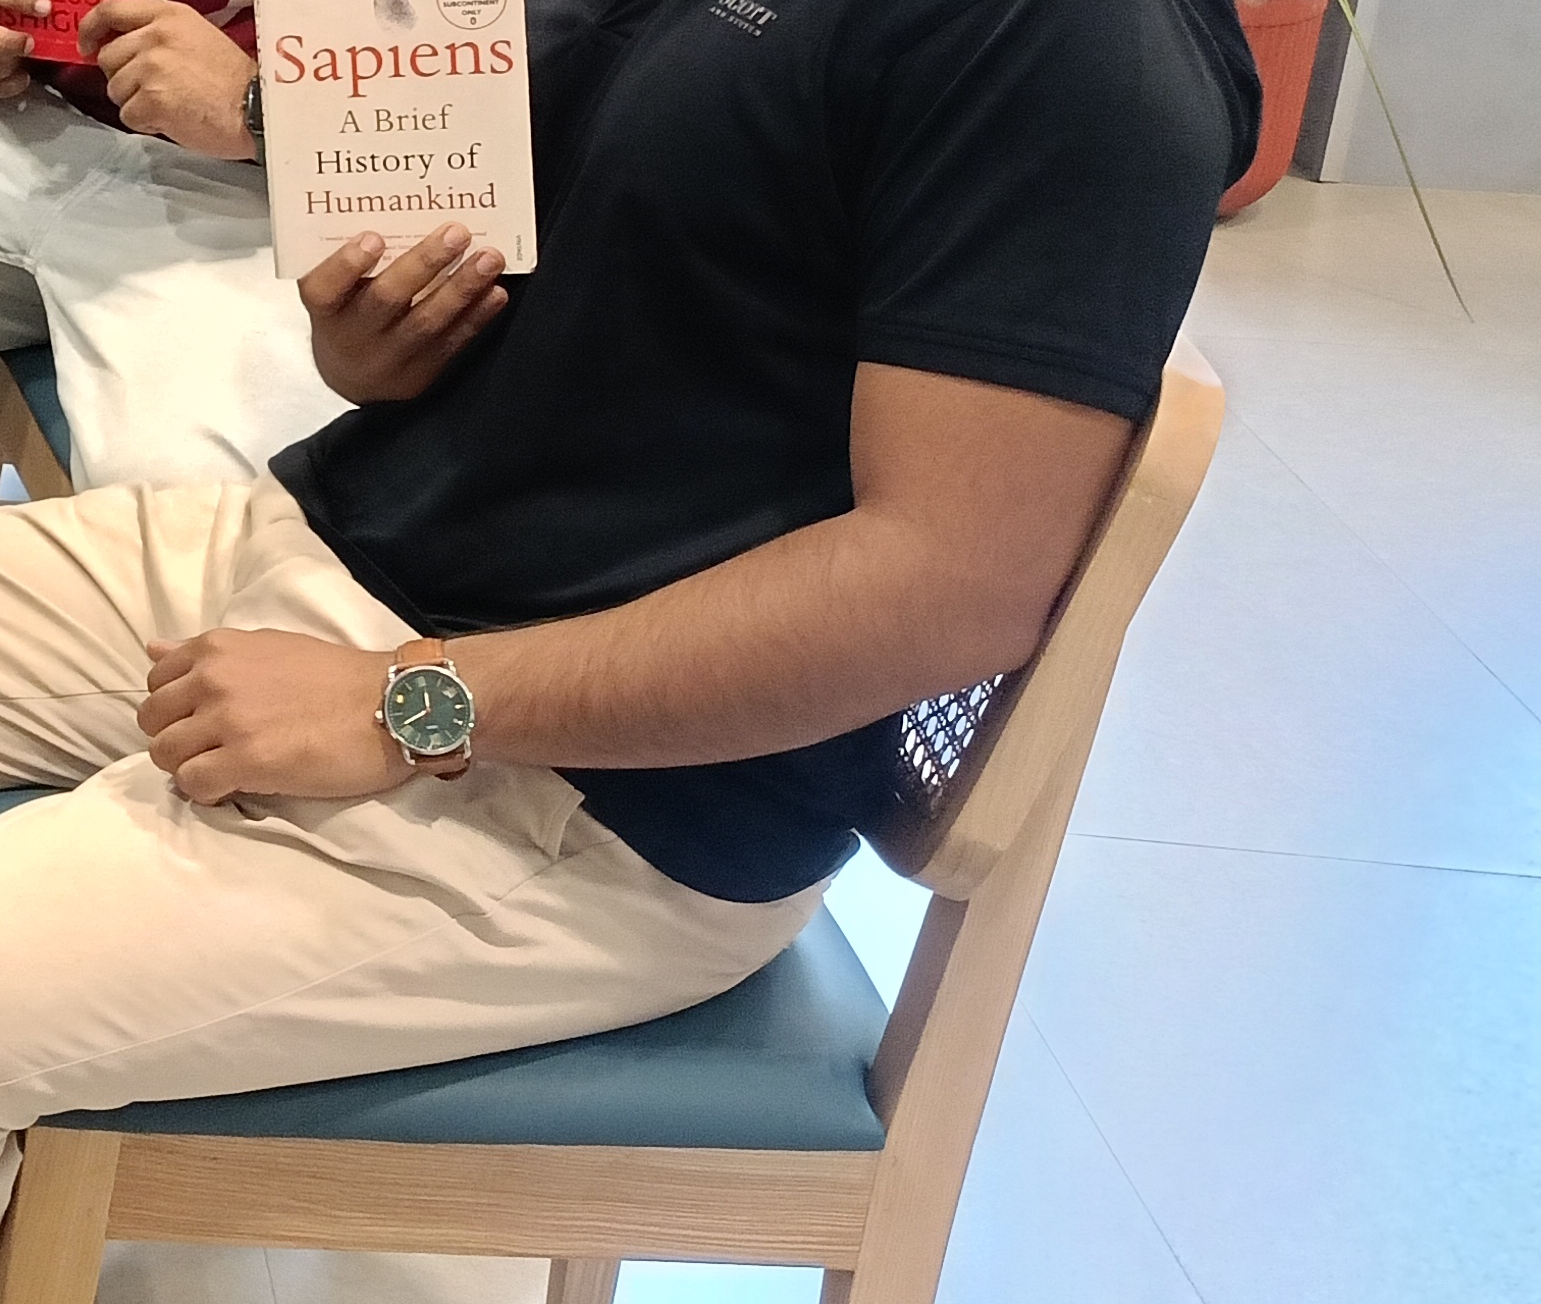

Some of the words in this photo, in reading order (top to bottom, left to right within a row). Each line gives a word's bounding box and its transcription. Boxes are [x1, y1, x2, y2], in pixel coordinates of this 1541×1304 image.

[443, 0, 499, 7] SUBCONTINENT
[274, 34, 514, 98] Sapiens
[339, 109, 363, 134] A
[374, 103, 453, 133] Brief
[315, 148, 435, 179] History
[446, 143, 482, 170] of
[305, 183, 498, 215] Humankind
